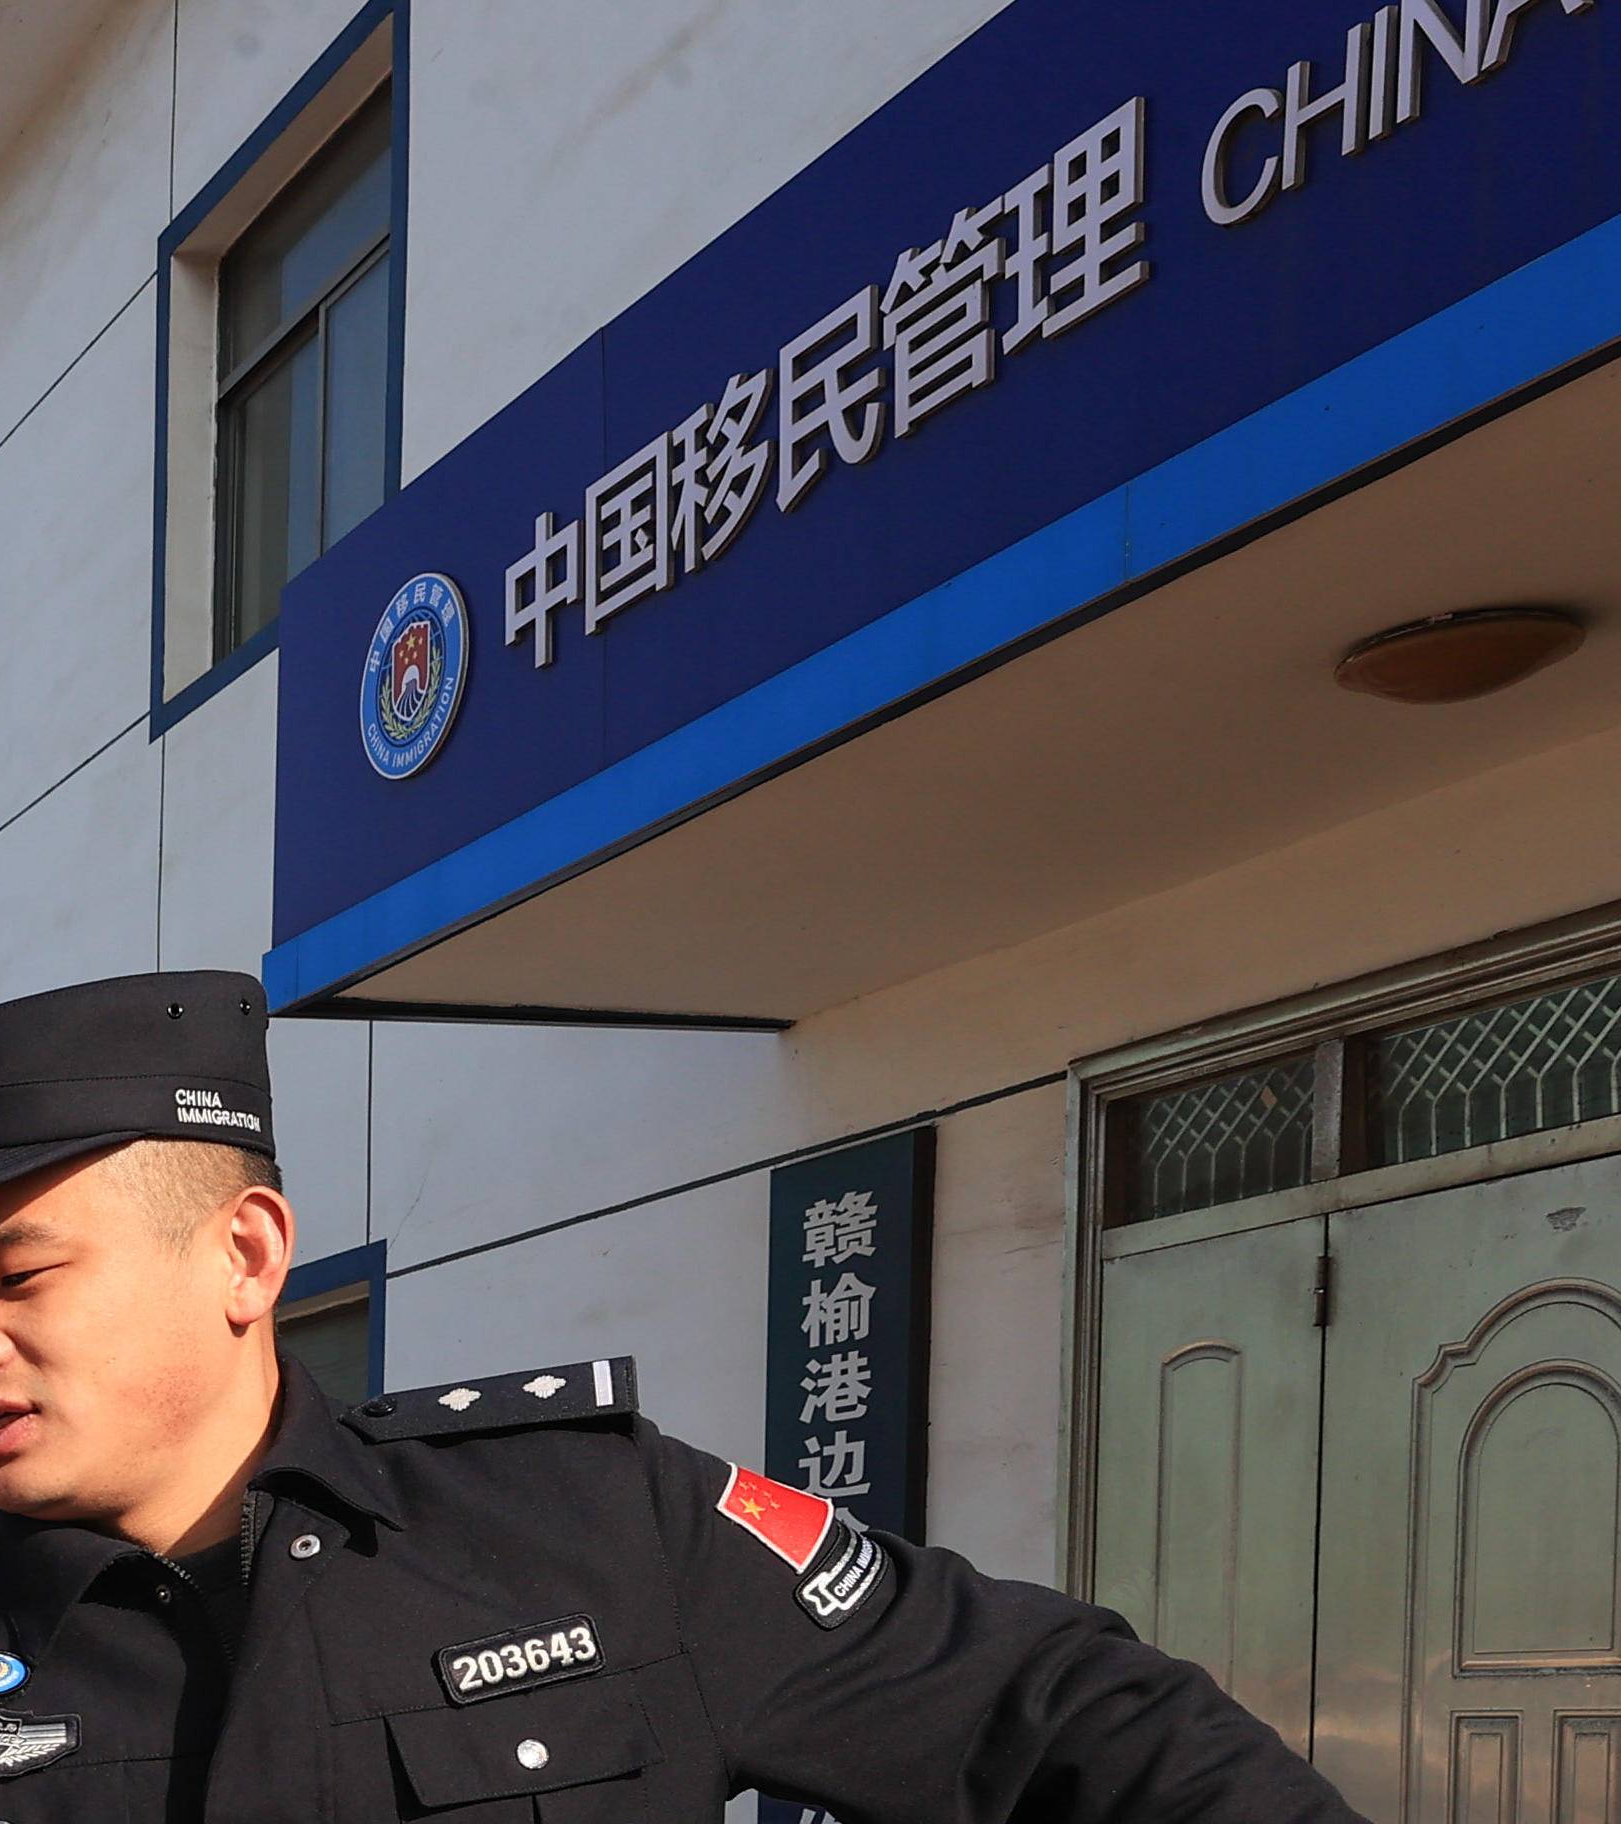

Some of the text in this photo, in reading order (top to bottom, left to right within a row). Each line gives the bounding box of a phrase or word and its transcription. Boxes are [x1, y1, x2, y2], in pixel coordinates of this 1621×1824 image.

[1201, 0, 1594, 226] CHIN
[504, 96, 1150, 669] 中国移民管理
[368, 581, 456, 673] 中国移民管理
[367, 676, 455, 768] CHINA IMMIGRATION
[175, 1088, 223, 1109] CHINA
[177, 1107, 262, 1133] IMMIGRATION
[799, 1189, 879, 1532] 赣榆港边
[834, 1566, 864, 1597] CHINA
[453, 1627, 596, 1693] 203643
